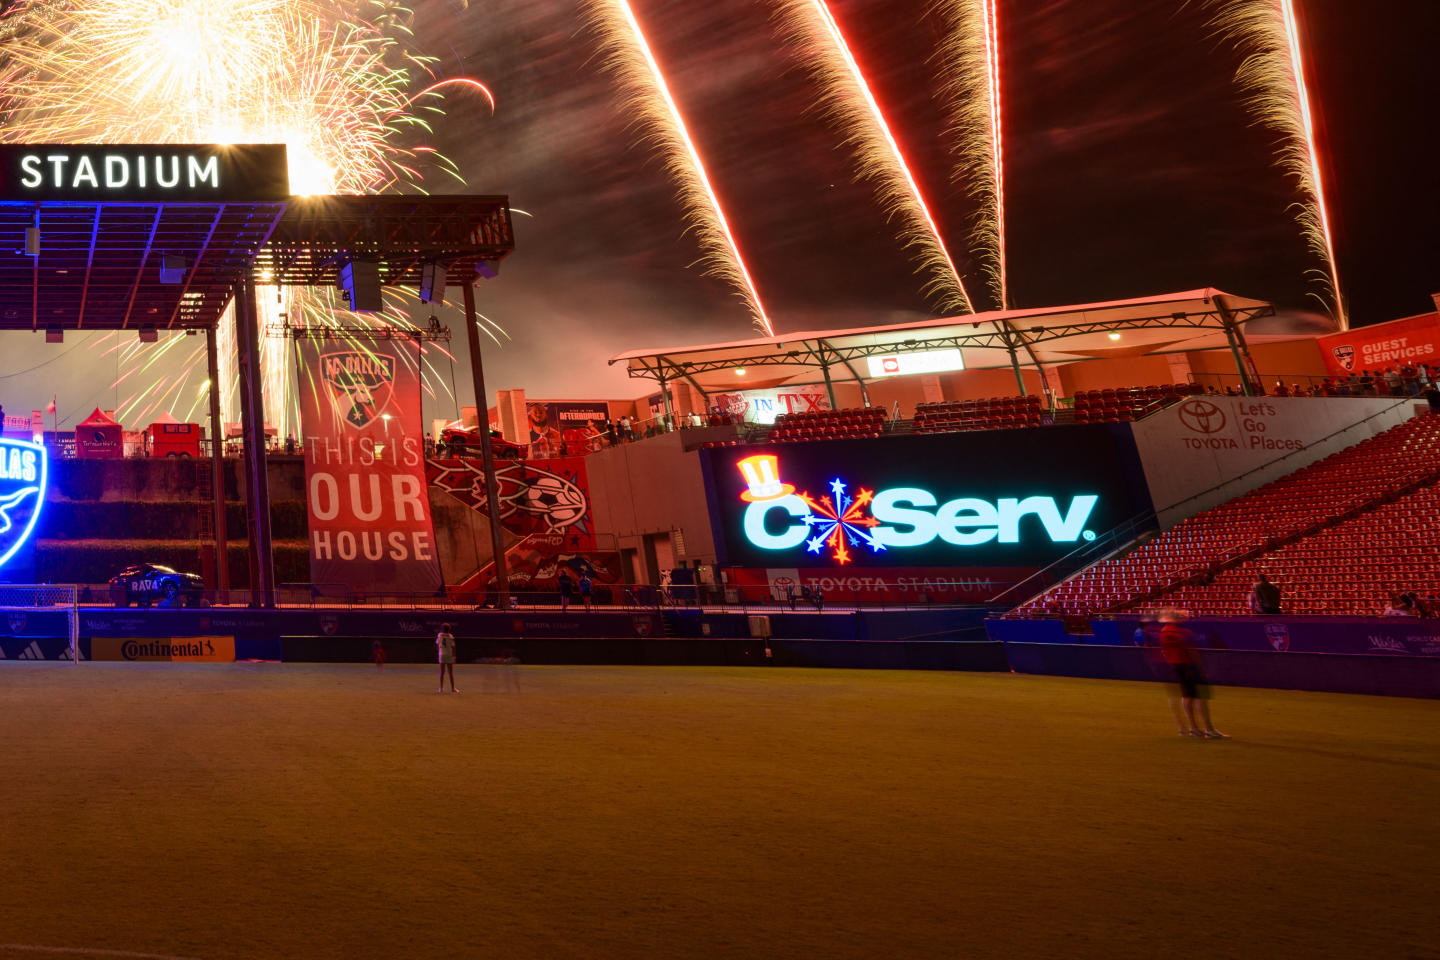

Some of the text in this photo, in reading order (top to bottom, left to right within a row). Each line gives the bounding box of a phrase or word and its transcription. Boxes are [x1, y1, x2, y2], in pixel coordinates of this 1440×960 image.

[20, 155, 220, 188] STADIUM
[1361, 337, 1408, 354] GUEST
[1363, 343, 1434, 365] SERVICES
[754, 398, 773, 411] IN
[777, 393, 823, 414] TX
[1239, 402, 1276, 417] Let's
[1243, 419, 1266, 433] Go
[307, 436, 419, 466] THIS IS
[1182, 438, 1239, 449] TOYOTA
[1250, 436, 1304, 450] Places
[310, 472, 426, 522] OUR
[313, 530, 432, 561] HOUSE
[806, 576, 993, 592] TOYOTA STADIUM
[121, 640, 204, 661] Continental
